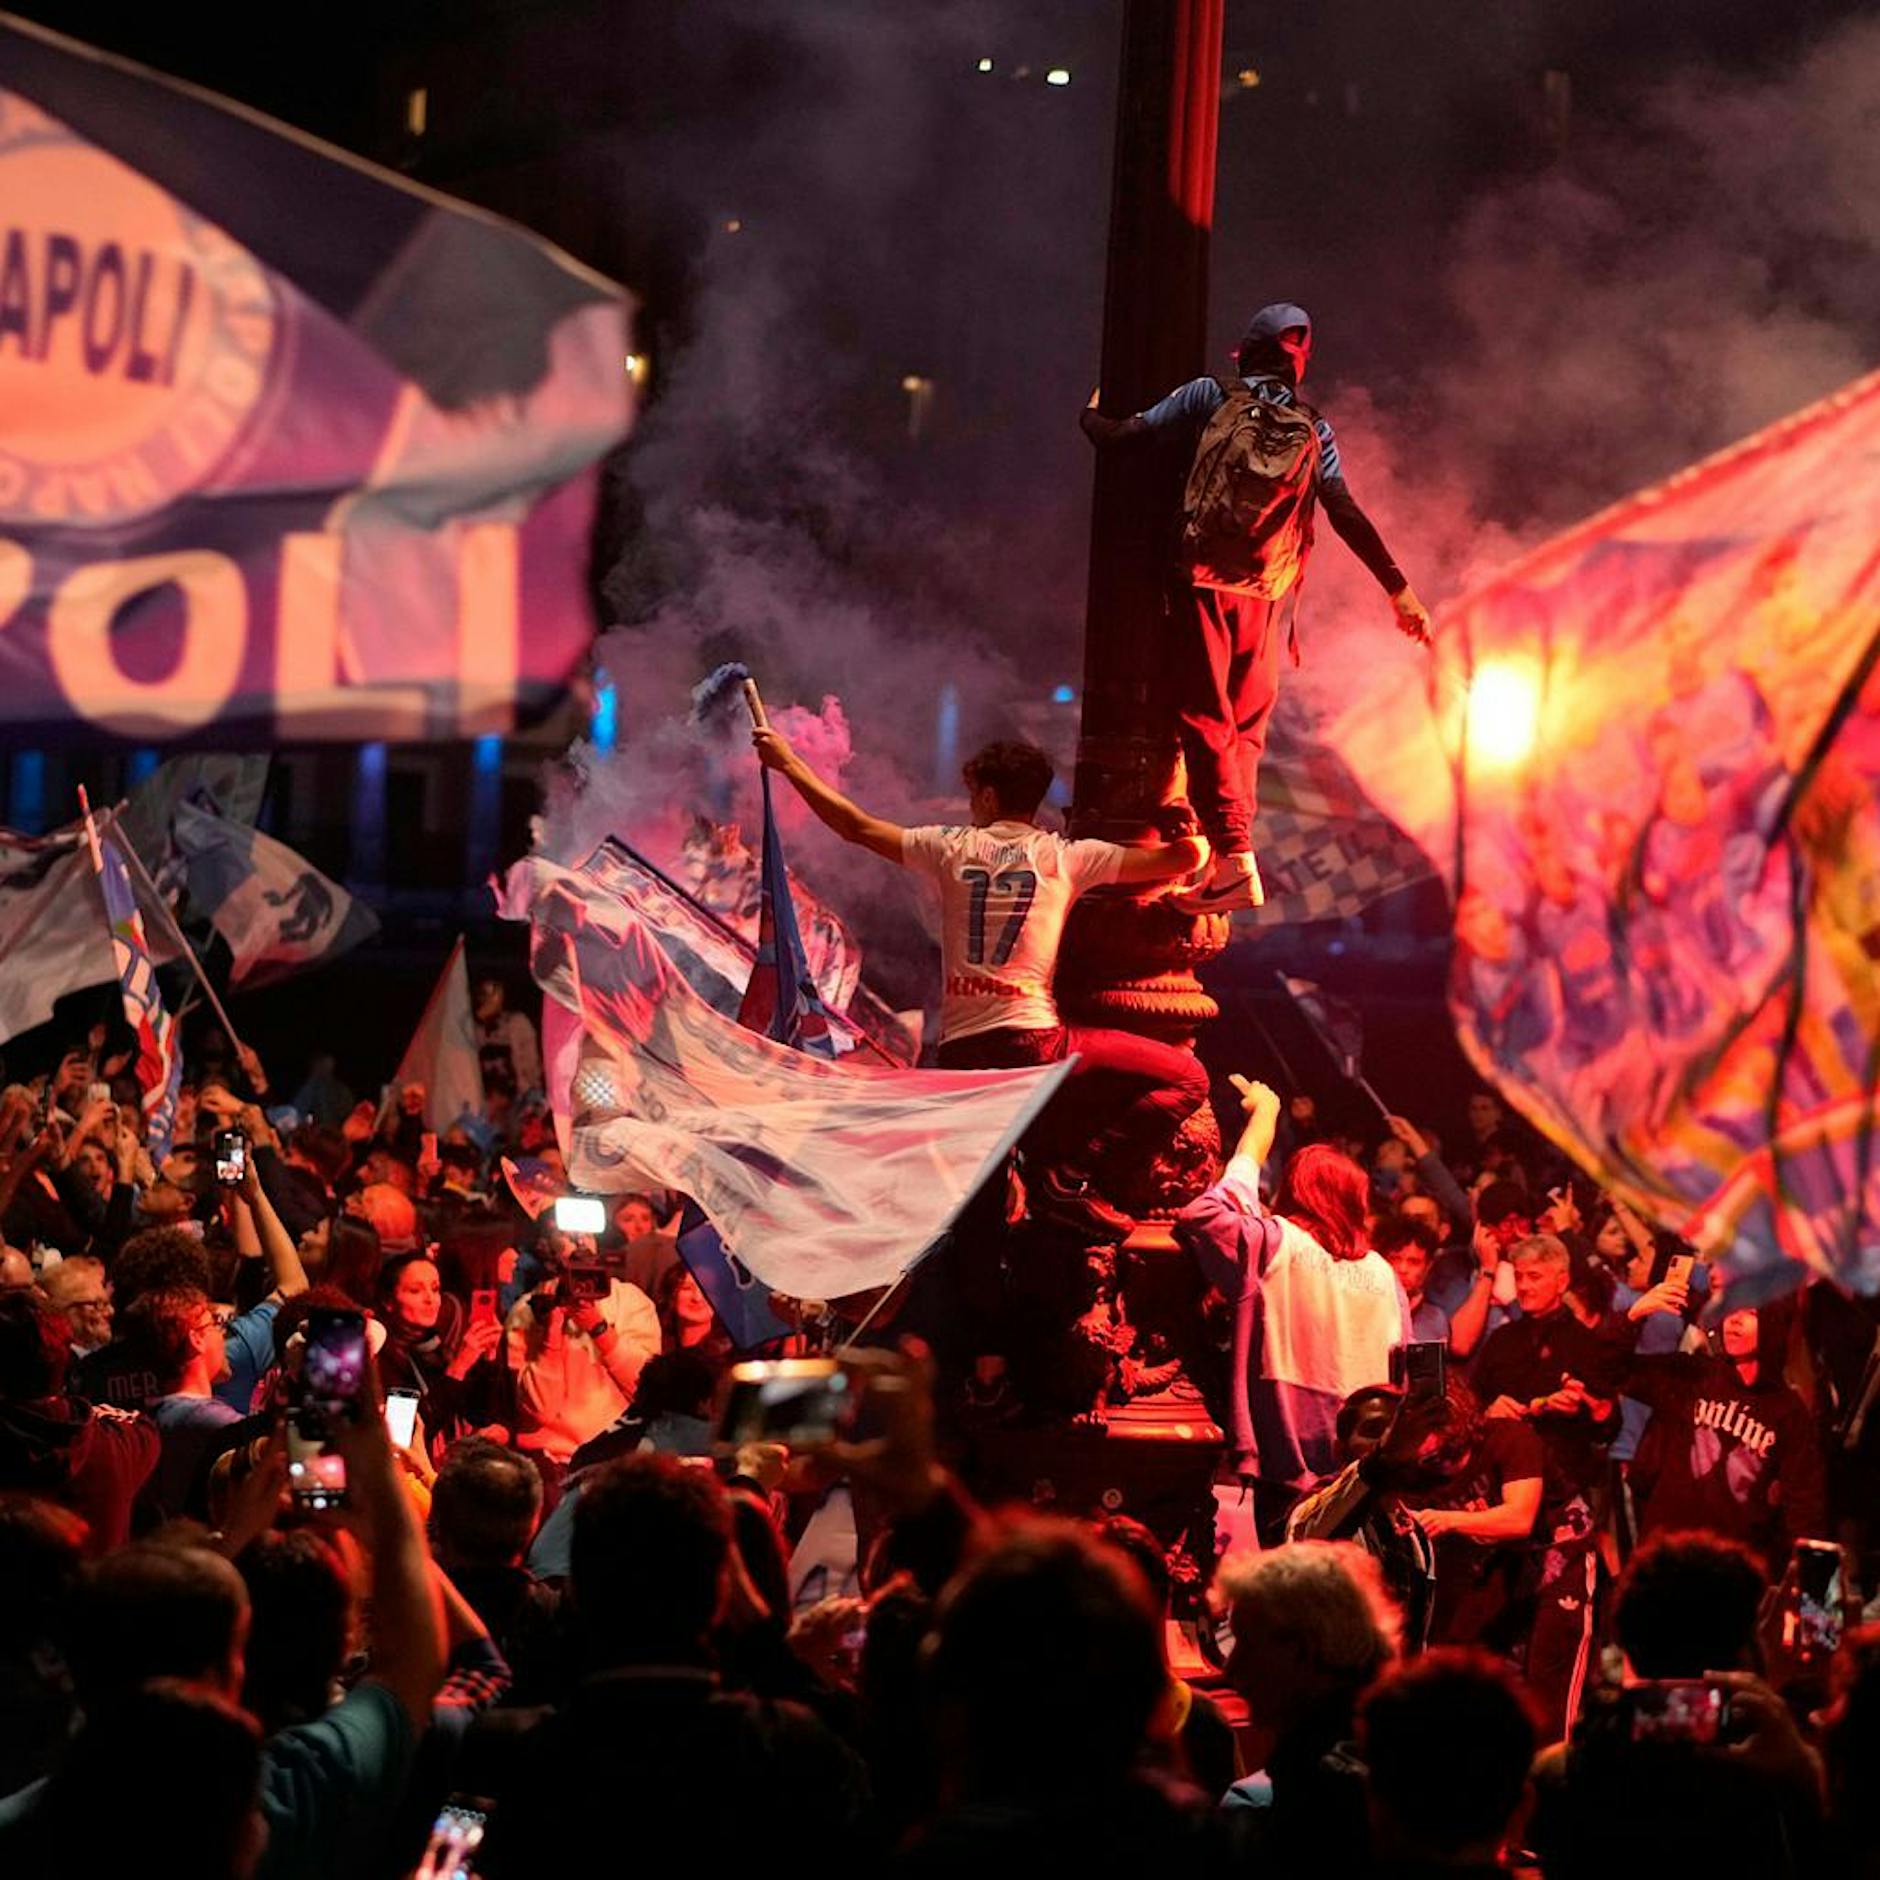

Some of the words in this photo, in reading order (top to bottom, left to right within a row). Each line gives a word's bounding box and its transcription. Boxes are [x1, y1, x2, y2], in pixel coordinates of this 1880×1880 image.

[0, 518, 518, 742] OLI
[962, 870, 1036, 966] 17
[1694, 1398, 1776, 1458] online
